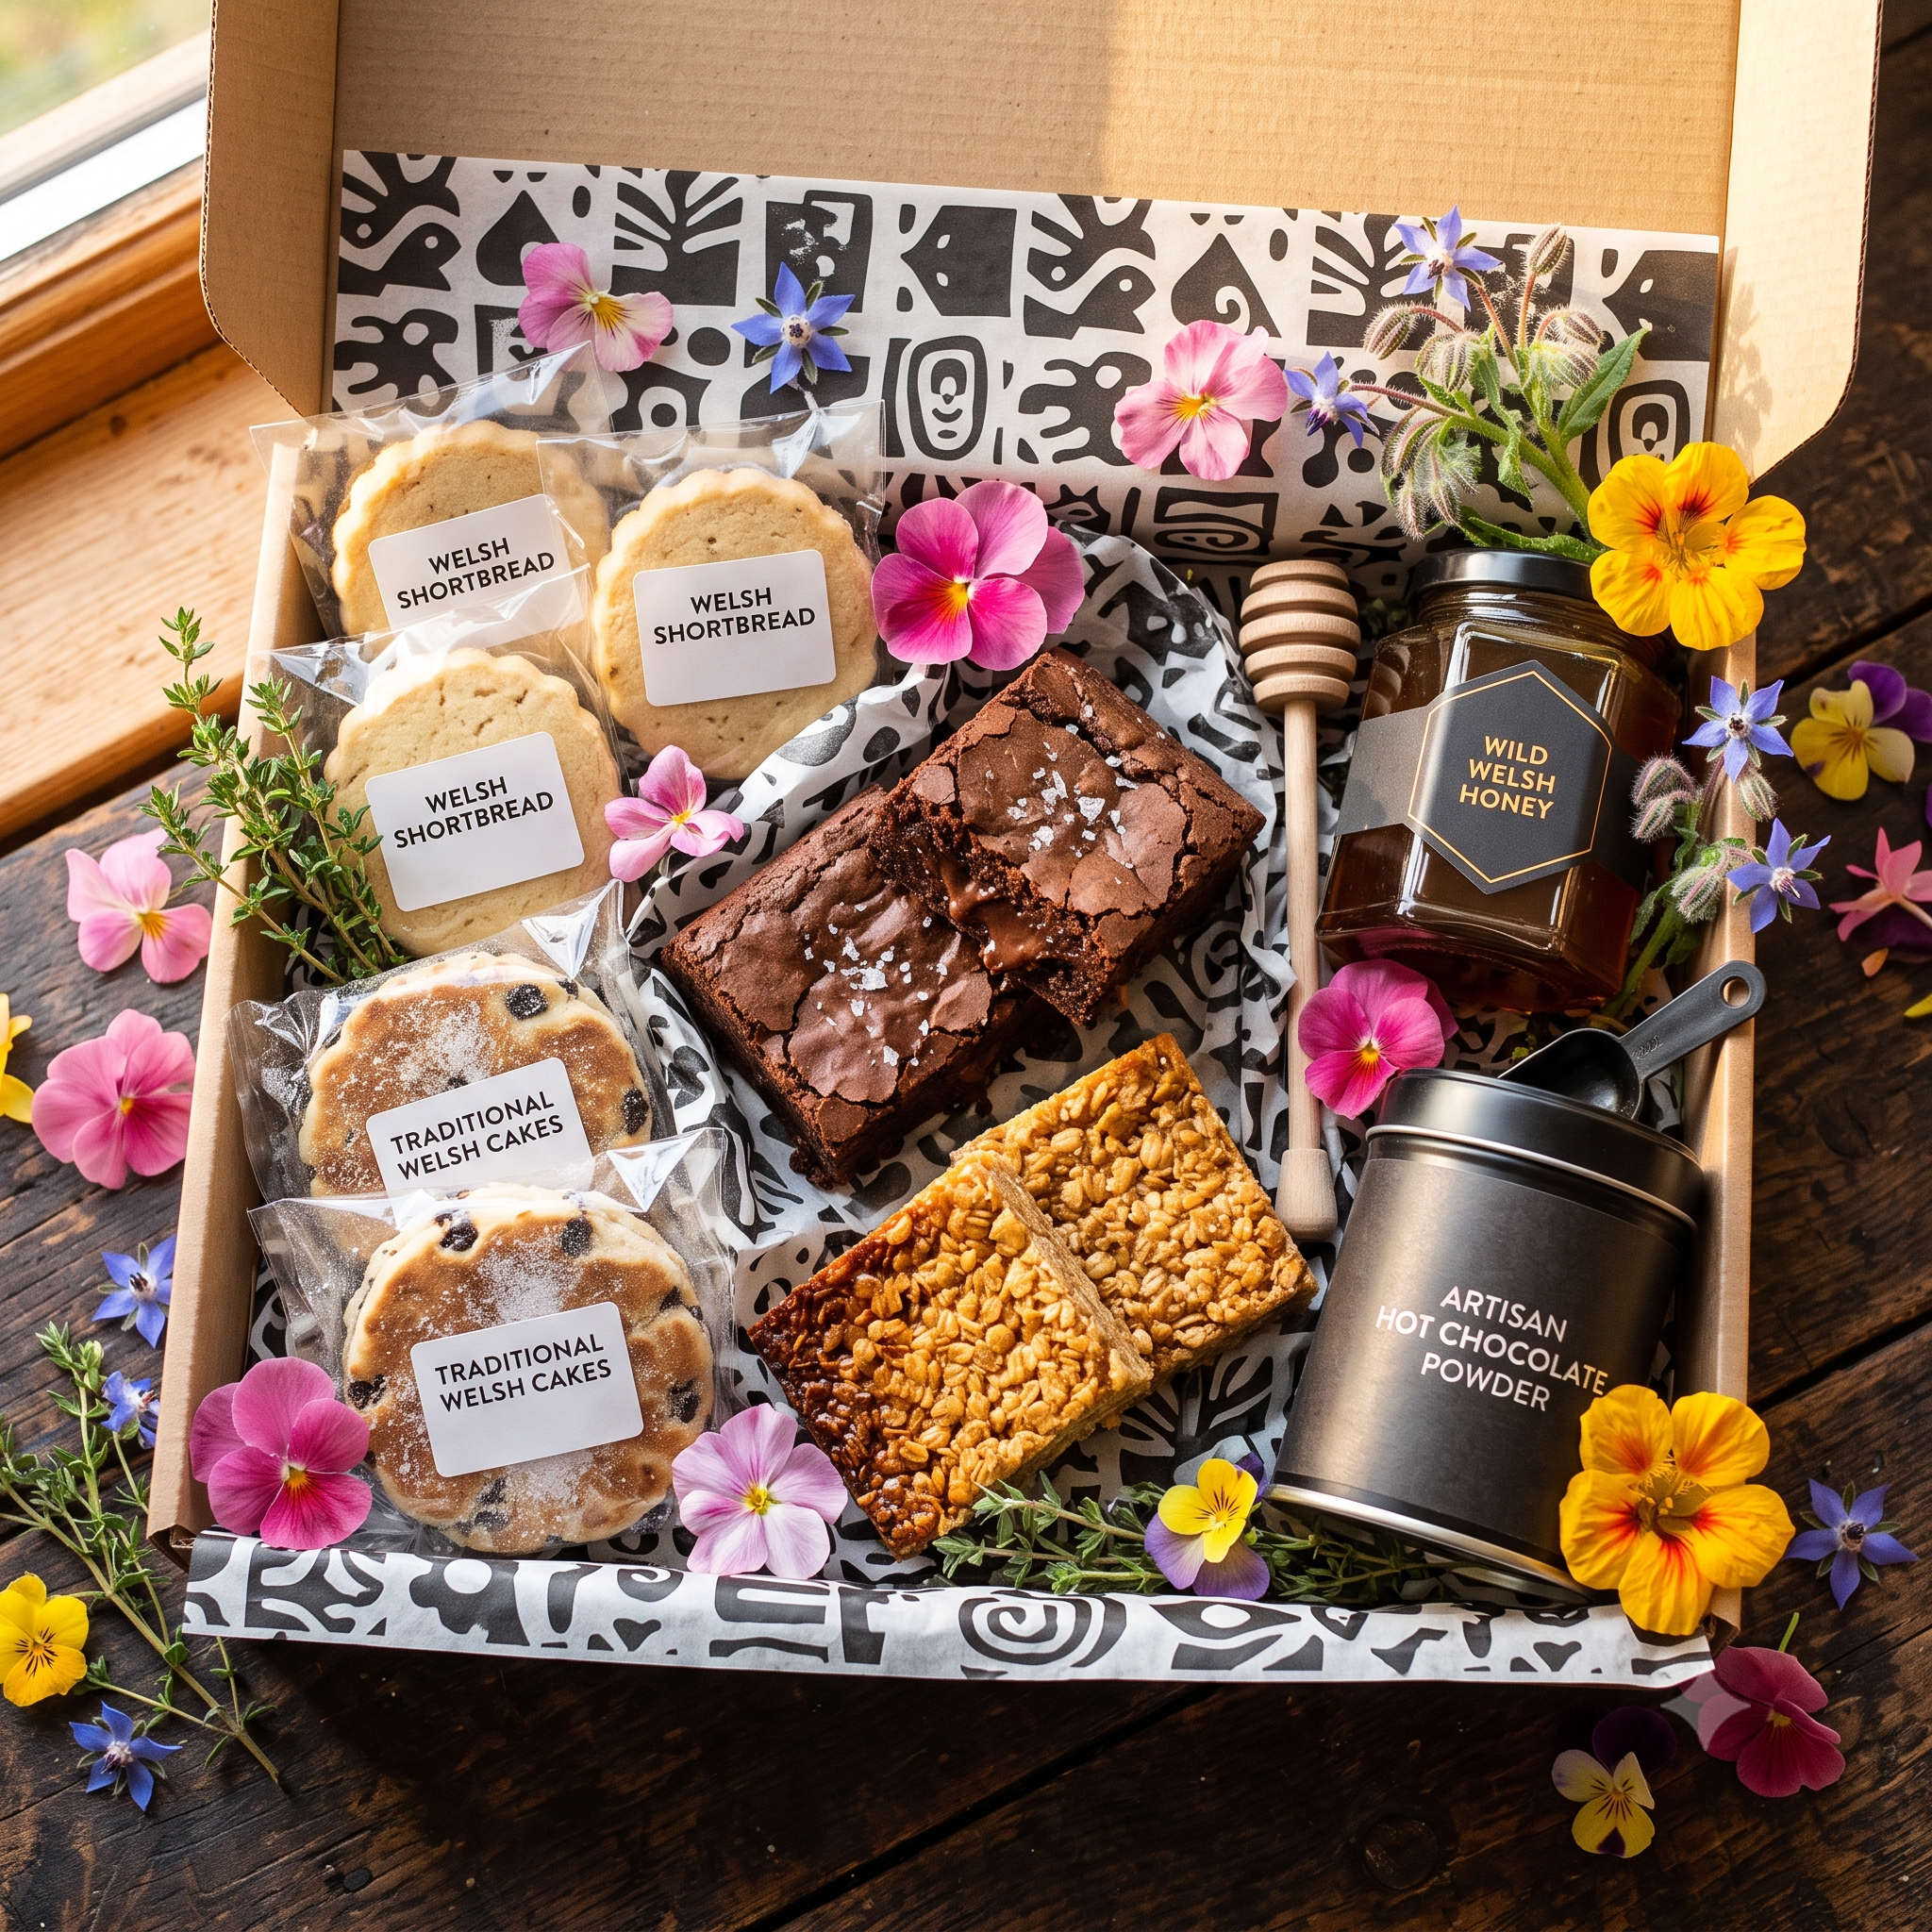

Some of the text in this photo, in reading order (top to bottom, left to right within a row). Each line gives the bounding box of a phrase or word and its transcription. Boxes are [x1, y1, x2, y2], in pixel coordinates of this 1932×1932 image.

[397, 552, 555, 609] SHORTBREAD
[428, 538, 510, 575] WELSH
[654, 608, 816, 644] SHORTBREAD
[691, 587, 773, 615] WELSH
[1469, 758, 1556, 794] WELSH
[1485, 735, 1548, 765] WILD
[393, 791, 555, 848] SHORTBREAD
[425, 776, 508, 814] WELSH
[1459, 783, 1554, 820] HONEY
[390, 1091, 555, 1156] TRADITIONAL
[397, 1114, 564, 1181] WELSH CAKES
[1440, 1286, 1567, 1342] ARTISAN
[435, 1333, 604, 1386] TRADITIONAL
[1375, 1305, 1608, 1395] HOT CHOCOLATE
[439, 1358, 612, 1412] WELSH CAKES
[1421, 1352, 1550, 1411] POWDER
